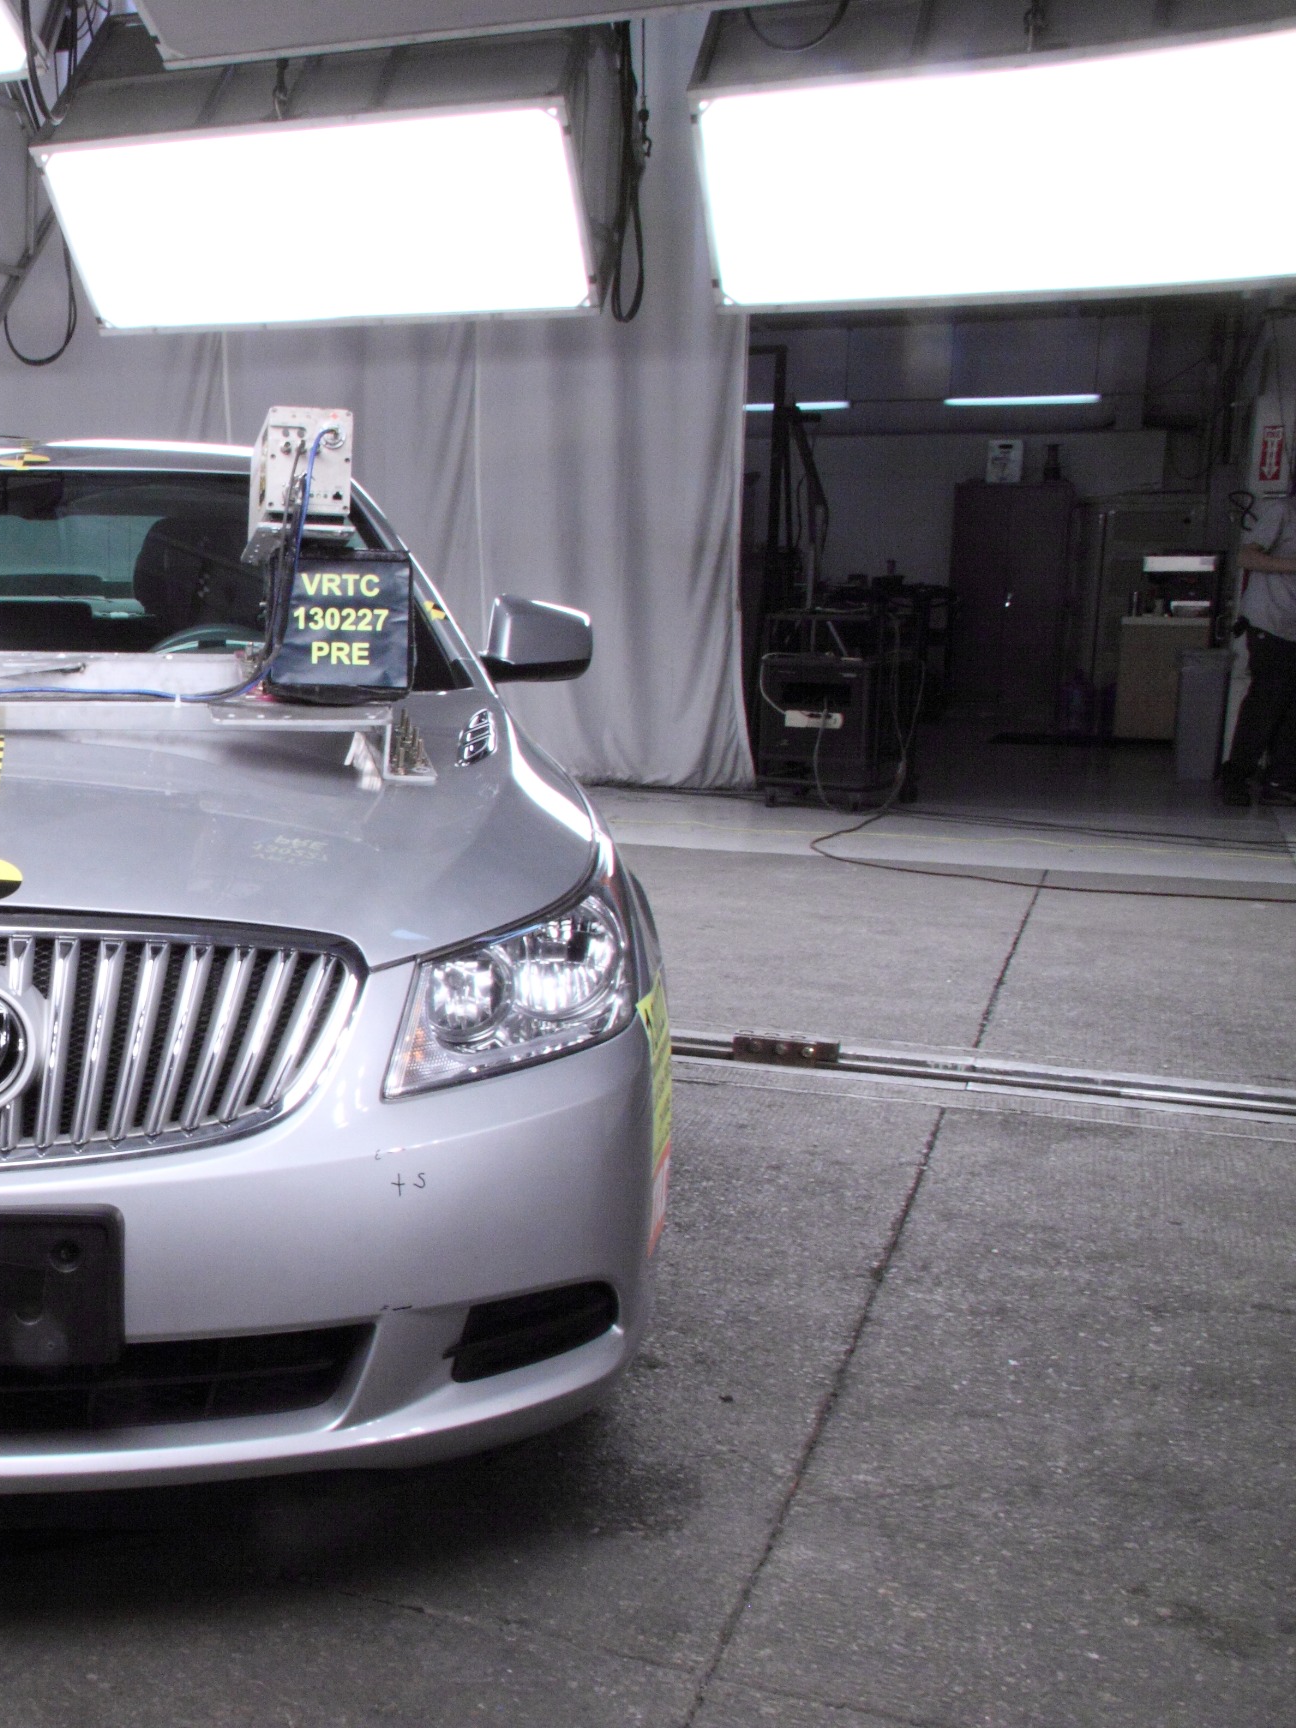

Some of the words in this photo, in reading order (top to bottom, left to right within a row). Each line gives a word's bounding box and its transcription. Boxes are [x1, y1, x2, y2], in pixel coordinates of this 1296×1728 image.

[300, 572, 380, 597] VRTC
[293, 608, 389, 632] 130227
[311, 641, 370, 665] PRE
